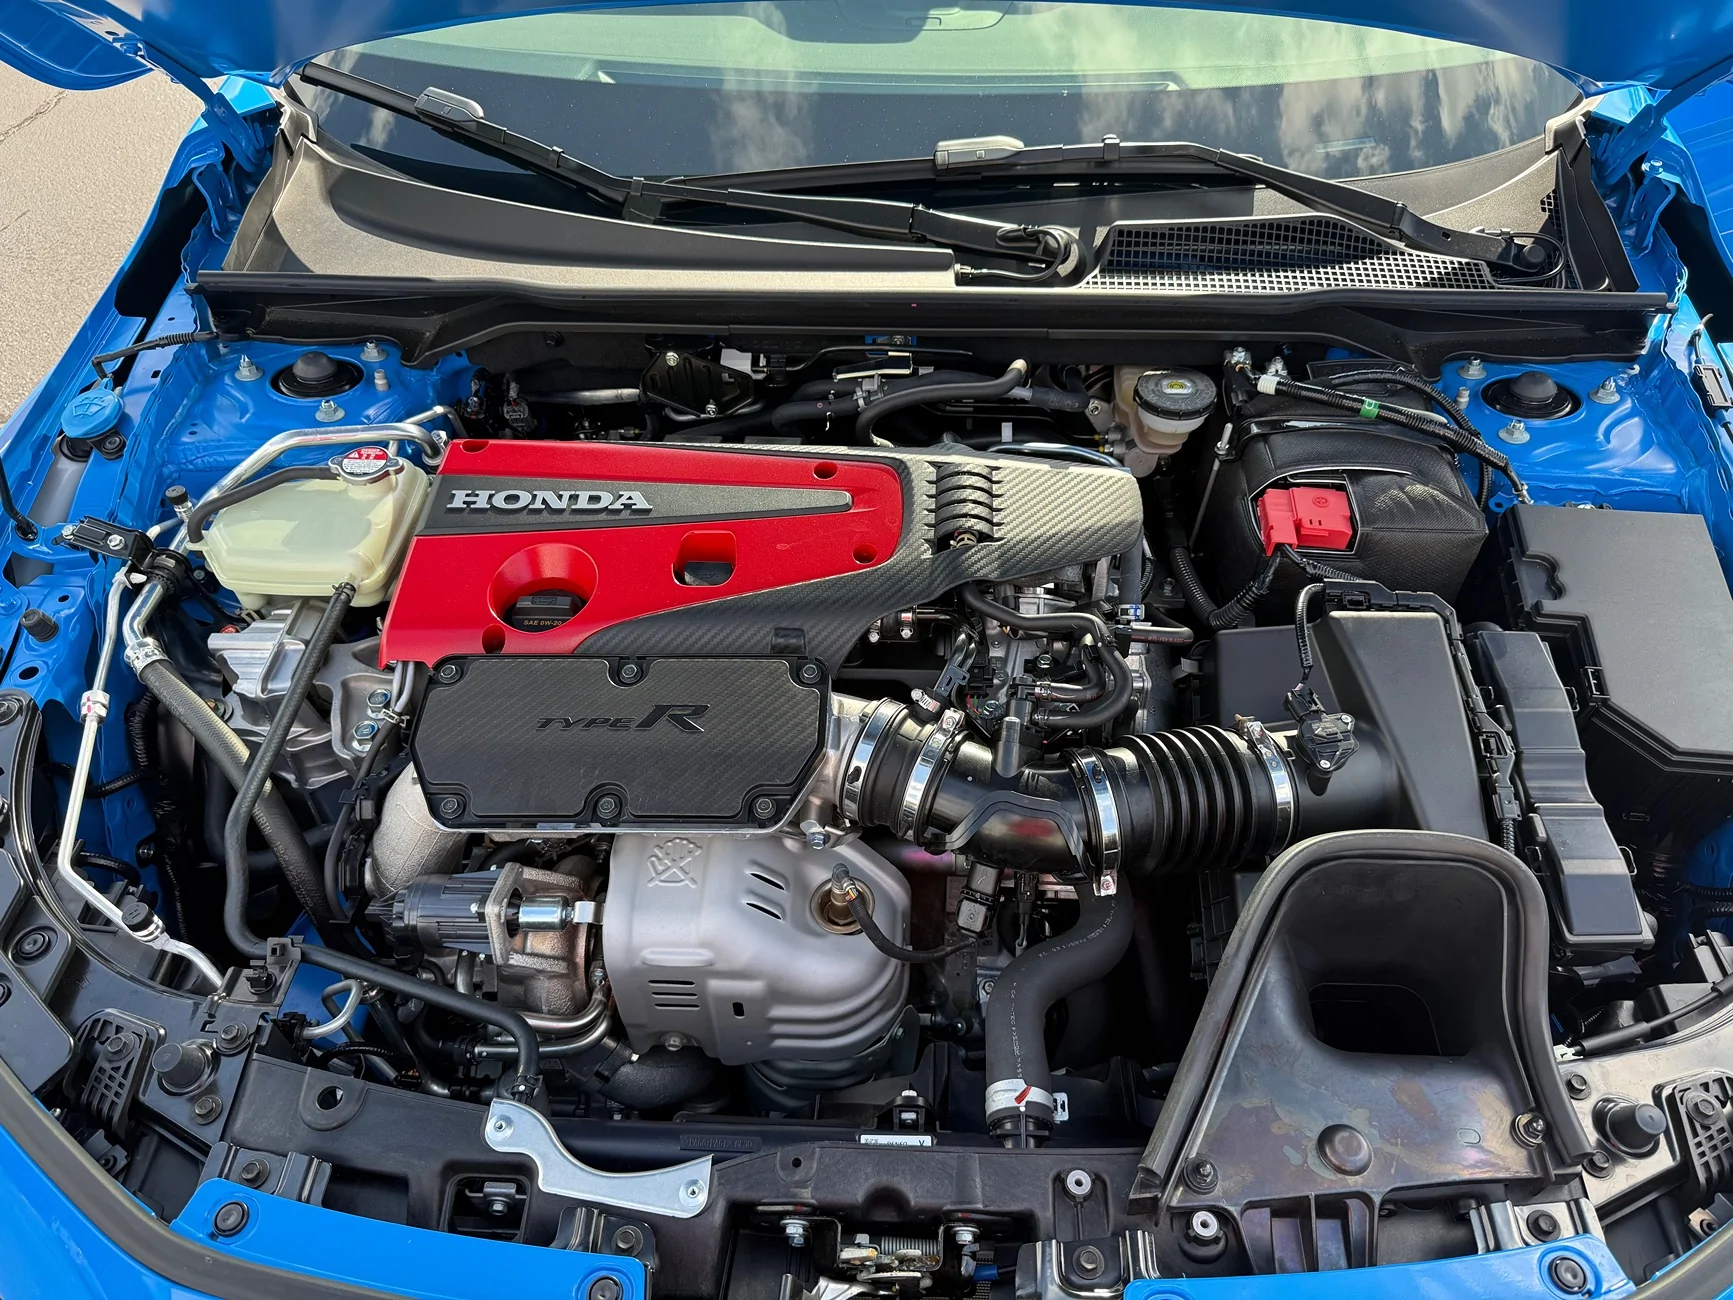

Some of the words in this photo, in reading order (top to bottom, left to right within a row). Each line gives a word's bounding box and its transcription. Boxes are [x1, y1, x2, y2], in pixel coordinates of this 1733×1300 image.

[446, 490, 653, 511] HONDA
[536, 717, 636, 731] TYPE
[634, 704, 710, 732] R
